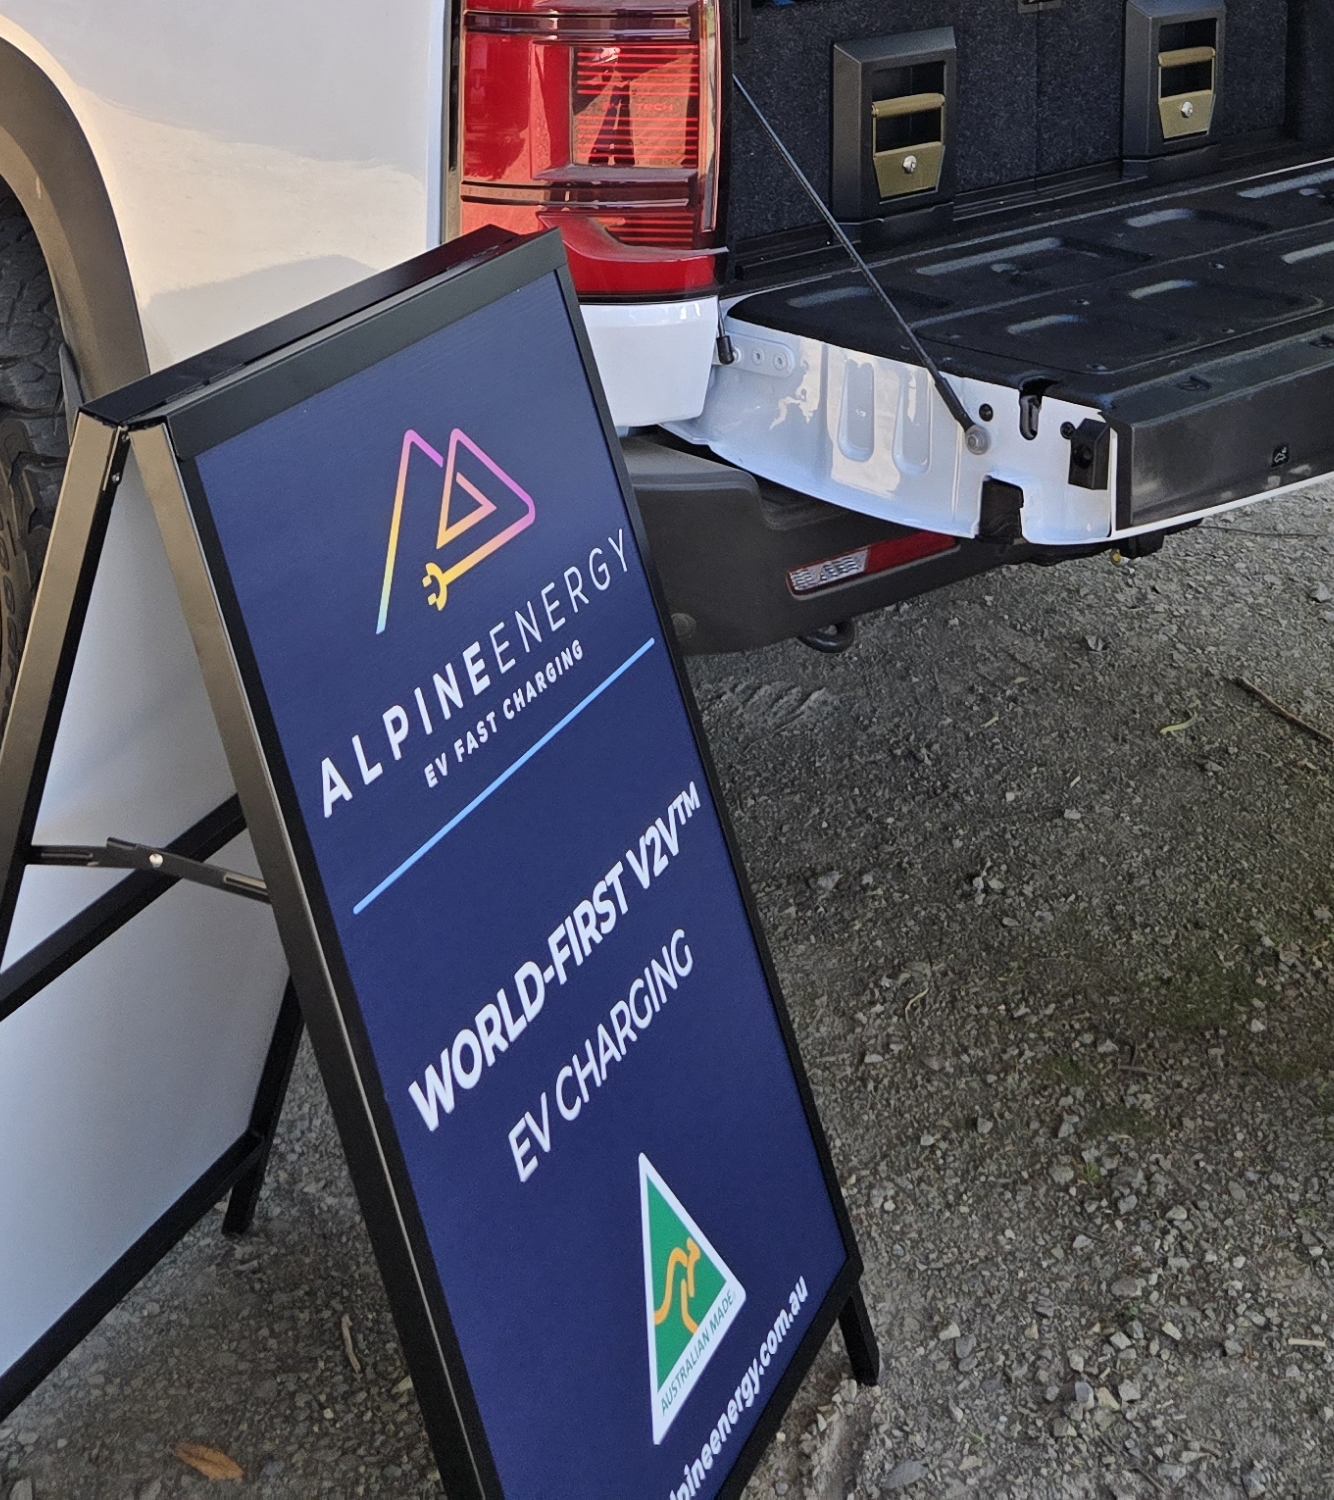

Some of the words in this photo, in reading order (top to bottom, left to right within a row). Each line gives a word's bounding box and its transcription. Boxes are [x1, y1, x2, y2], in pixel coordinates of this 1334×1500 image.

[319, 527, 631, 819] ALPINEENERGY
[423, 753, 448, 788] EV
[453, 711, 499, 763] FAST
[502, 638, 584, 720] CHARGING
[407, 861, 630, 1132] WORLD-FIRST
[507, 1092, 552, 1183] EV
[554, 928, 695, 1121] CHARGING
[660, 1329, 711, 1417] AUSTRALIAN
[709, 1288, 735, 1337] MADE
